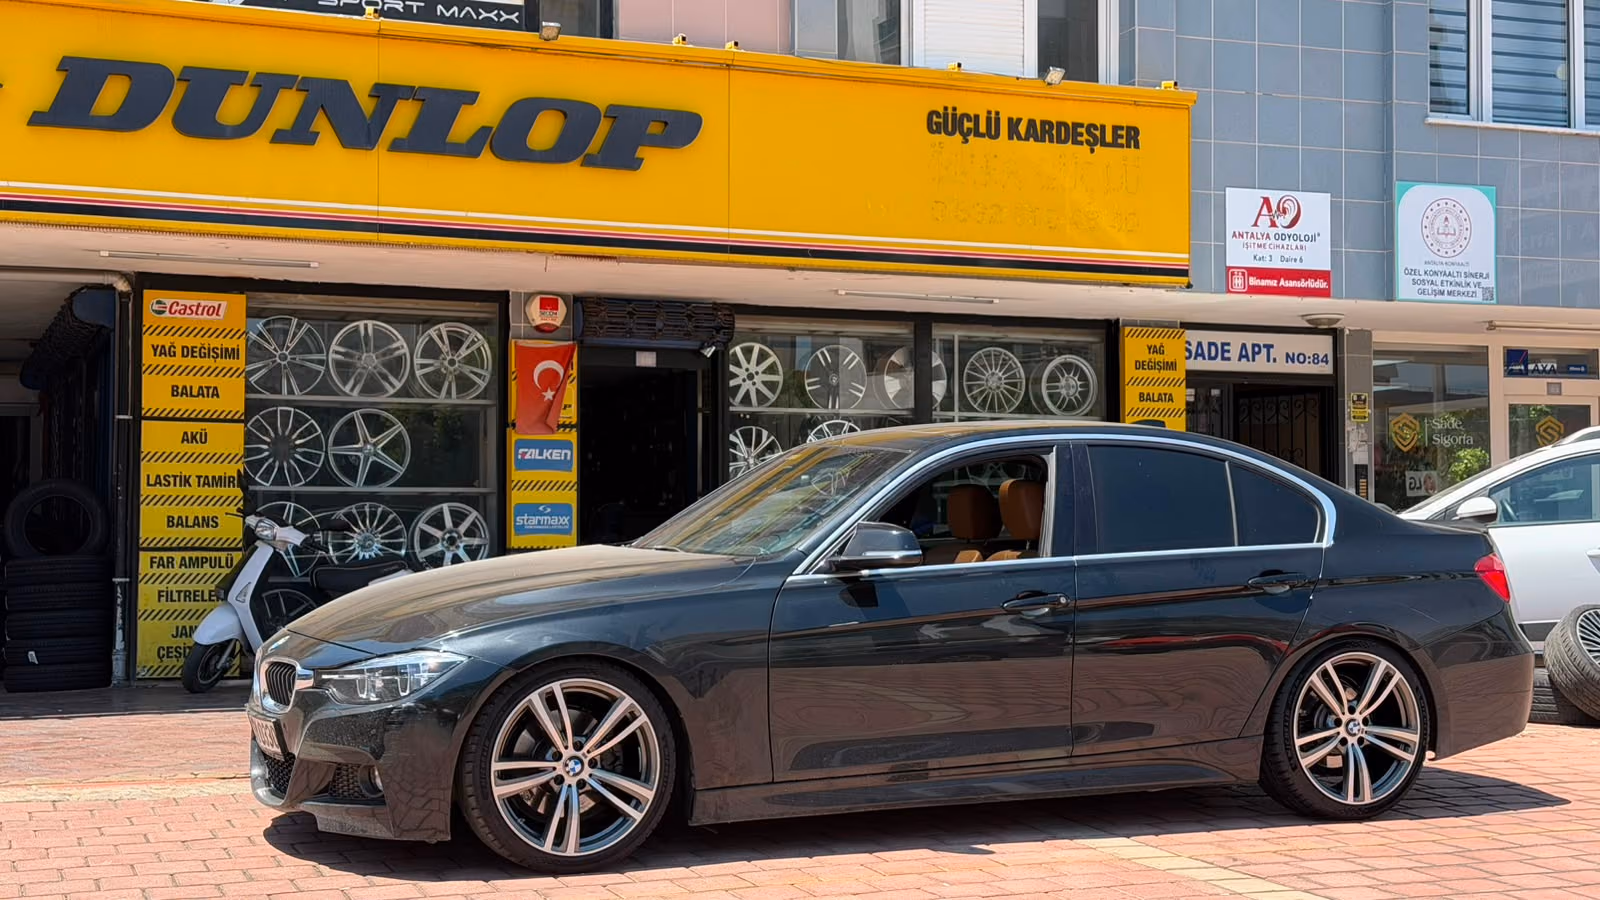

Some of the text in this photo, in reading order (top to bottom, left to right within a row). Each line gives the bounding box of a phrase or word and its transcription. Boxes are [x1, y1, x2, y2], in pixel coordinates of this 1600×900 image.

[437, 5, 520, 24] MAXX
[27, 55, 703, 171] DUNLOP
[926, 106, 1140, 154] GÜÇLÜ KARDEŞLER
[1232, 231, 1271, 241] ANTALYA
[1242, 242, 1307, 252] İŞİTME CİHAZLARI
[1280, 255, 1298, 263] Daire
[1403, 267, 1422, 276] ÖZEL
[1424, 269, 1462, 279] KONYAALTI
[1248, 276, 1278, 287] Binamız
[1411, 278, 1482, 289] SOSYAL ETKİNLİK VE
[1417, 287, 1445, 298] GELİŞİM
[168, 300, 222, 317] Castrol
[151, 342, 240, 362] YAĞ DEĞİŞİMİ
[1146, 343, 1165, 356] YAĞ
[1237, 342, 1277, 363] APT.
[1285, 352, 1329, 366] NO:84
[1134, 359, 1177, 373] DEĞİŞİMİ
[1531, 363, 1557, 374] AXA
[171, 384, 220, 399] BALATA
[1138, 391, 1174, 404] BALATA
[181, 428, 208, 445] AKÜ
[518, 448, 571, 461] FALKEN
[146, 472, 192, 489] LASTİK
[166, 515, 219, 529] BALANS
[516, 513, 570, 527] starmaxx
[149, 553, 234, 569] FAR AMPULÜ
[157, 587, 223, 603] FİLTRELE
